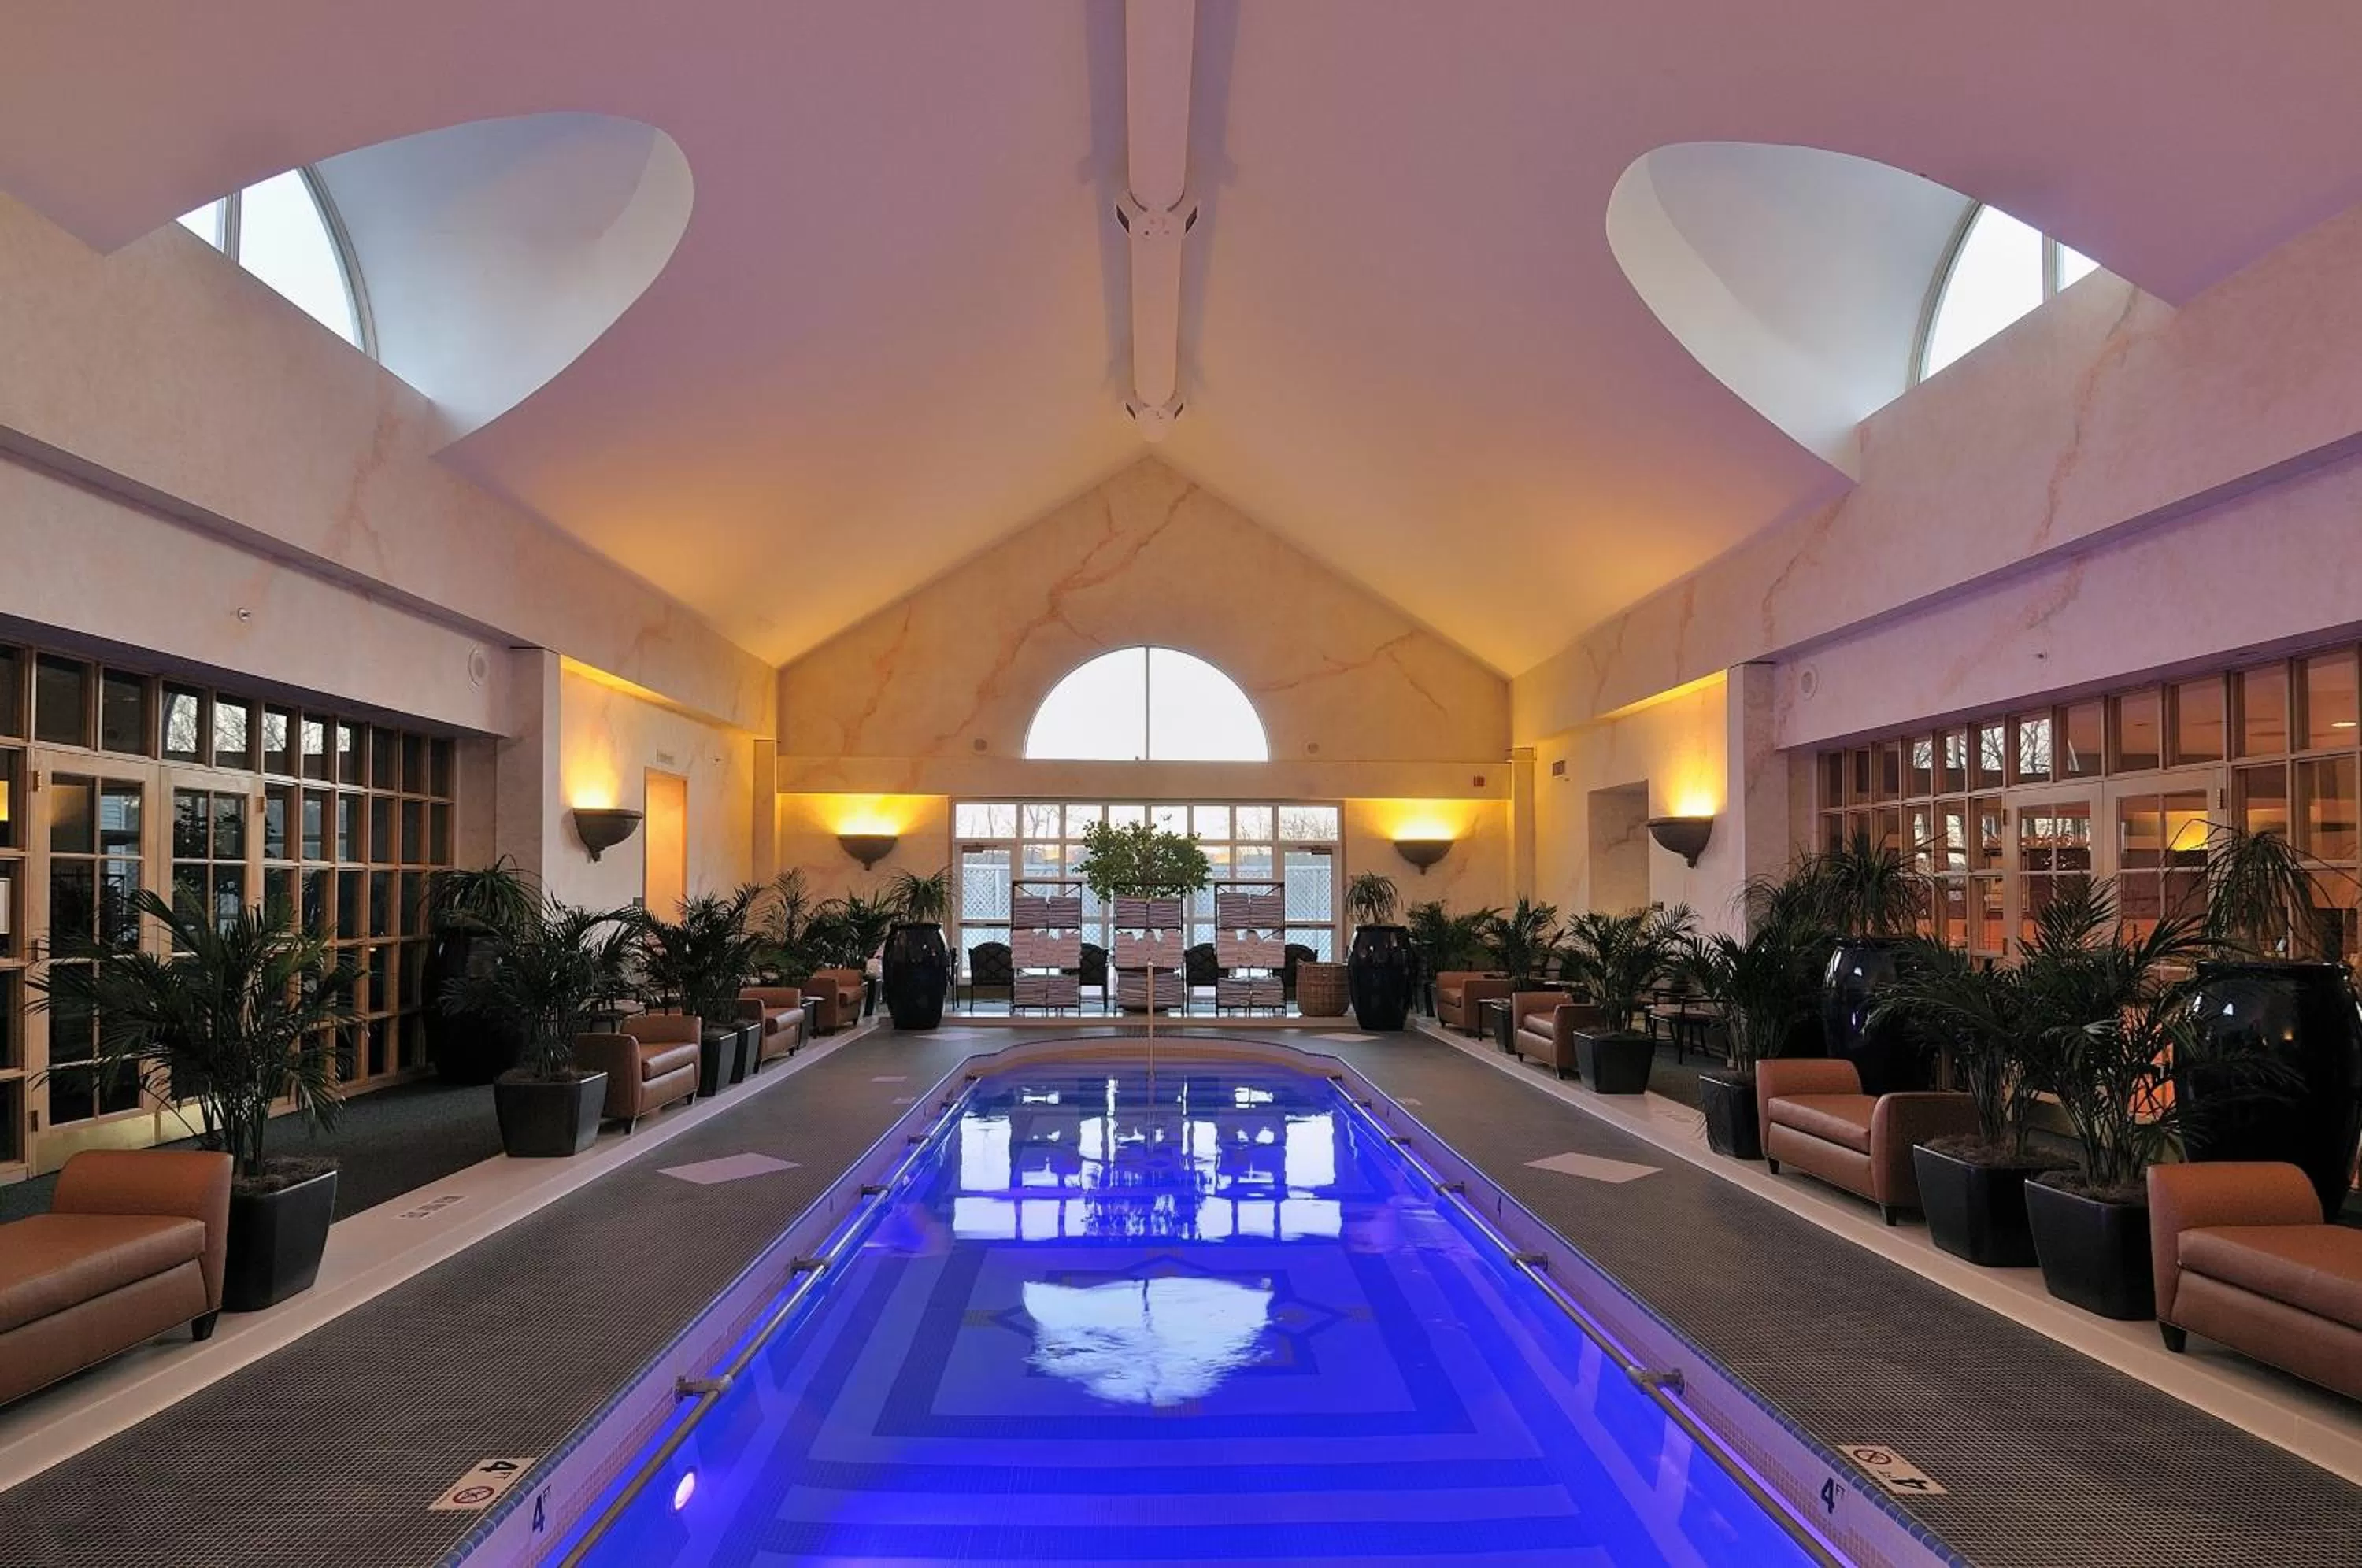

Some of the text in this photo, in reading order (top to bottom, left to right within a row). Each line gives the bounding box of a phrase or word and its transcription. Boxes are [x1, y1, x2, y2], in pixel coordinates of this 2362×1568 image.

[479, 1460, 519, 1473] 4
[1820, 1477, 1835, 1514] 4
[1890, 1477, 1928, 1490] 4
[531, 1494, 546, 1533] 4
